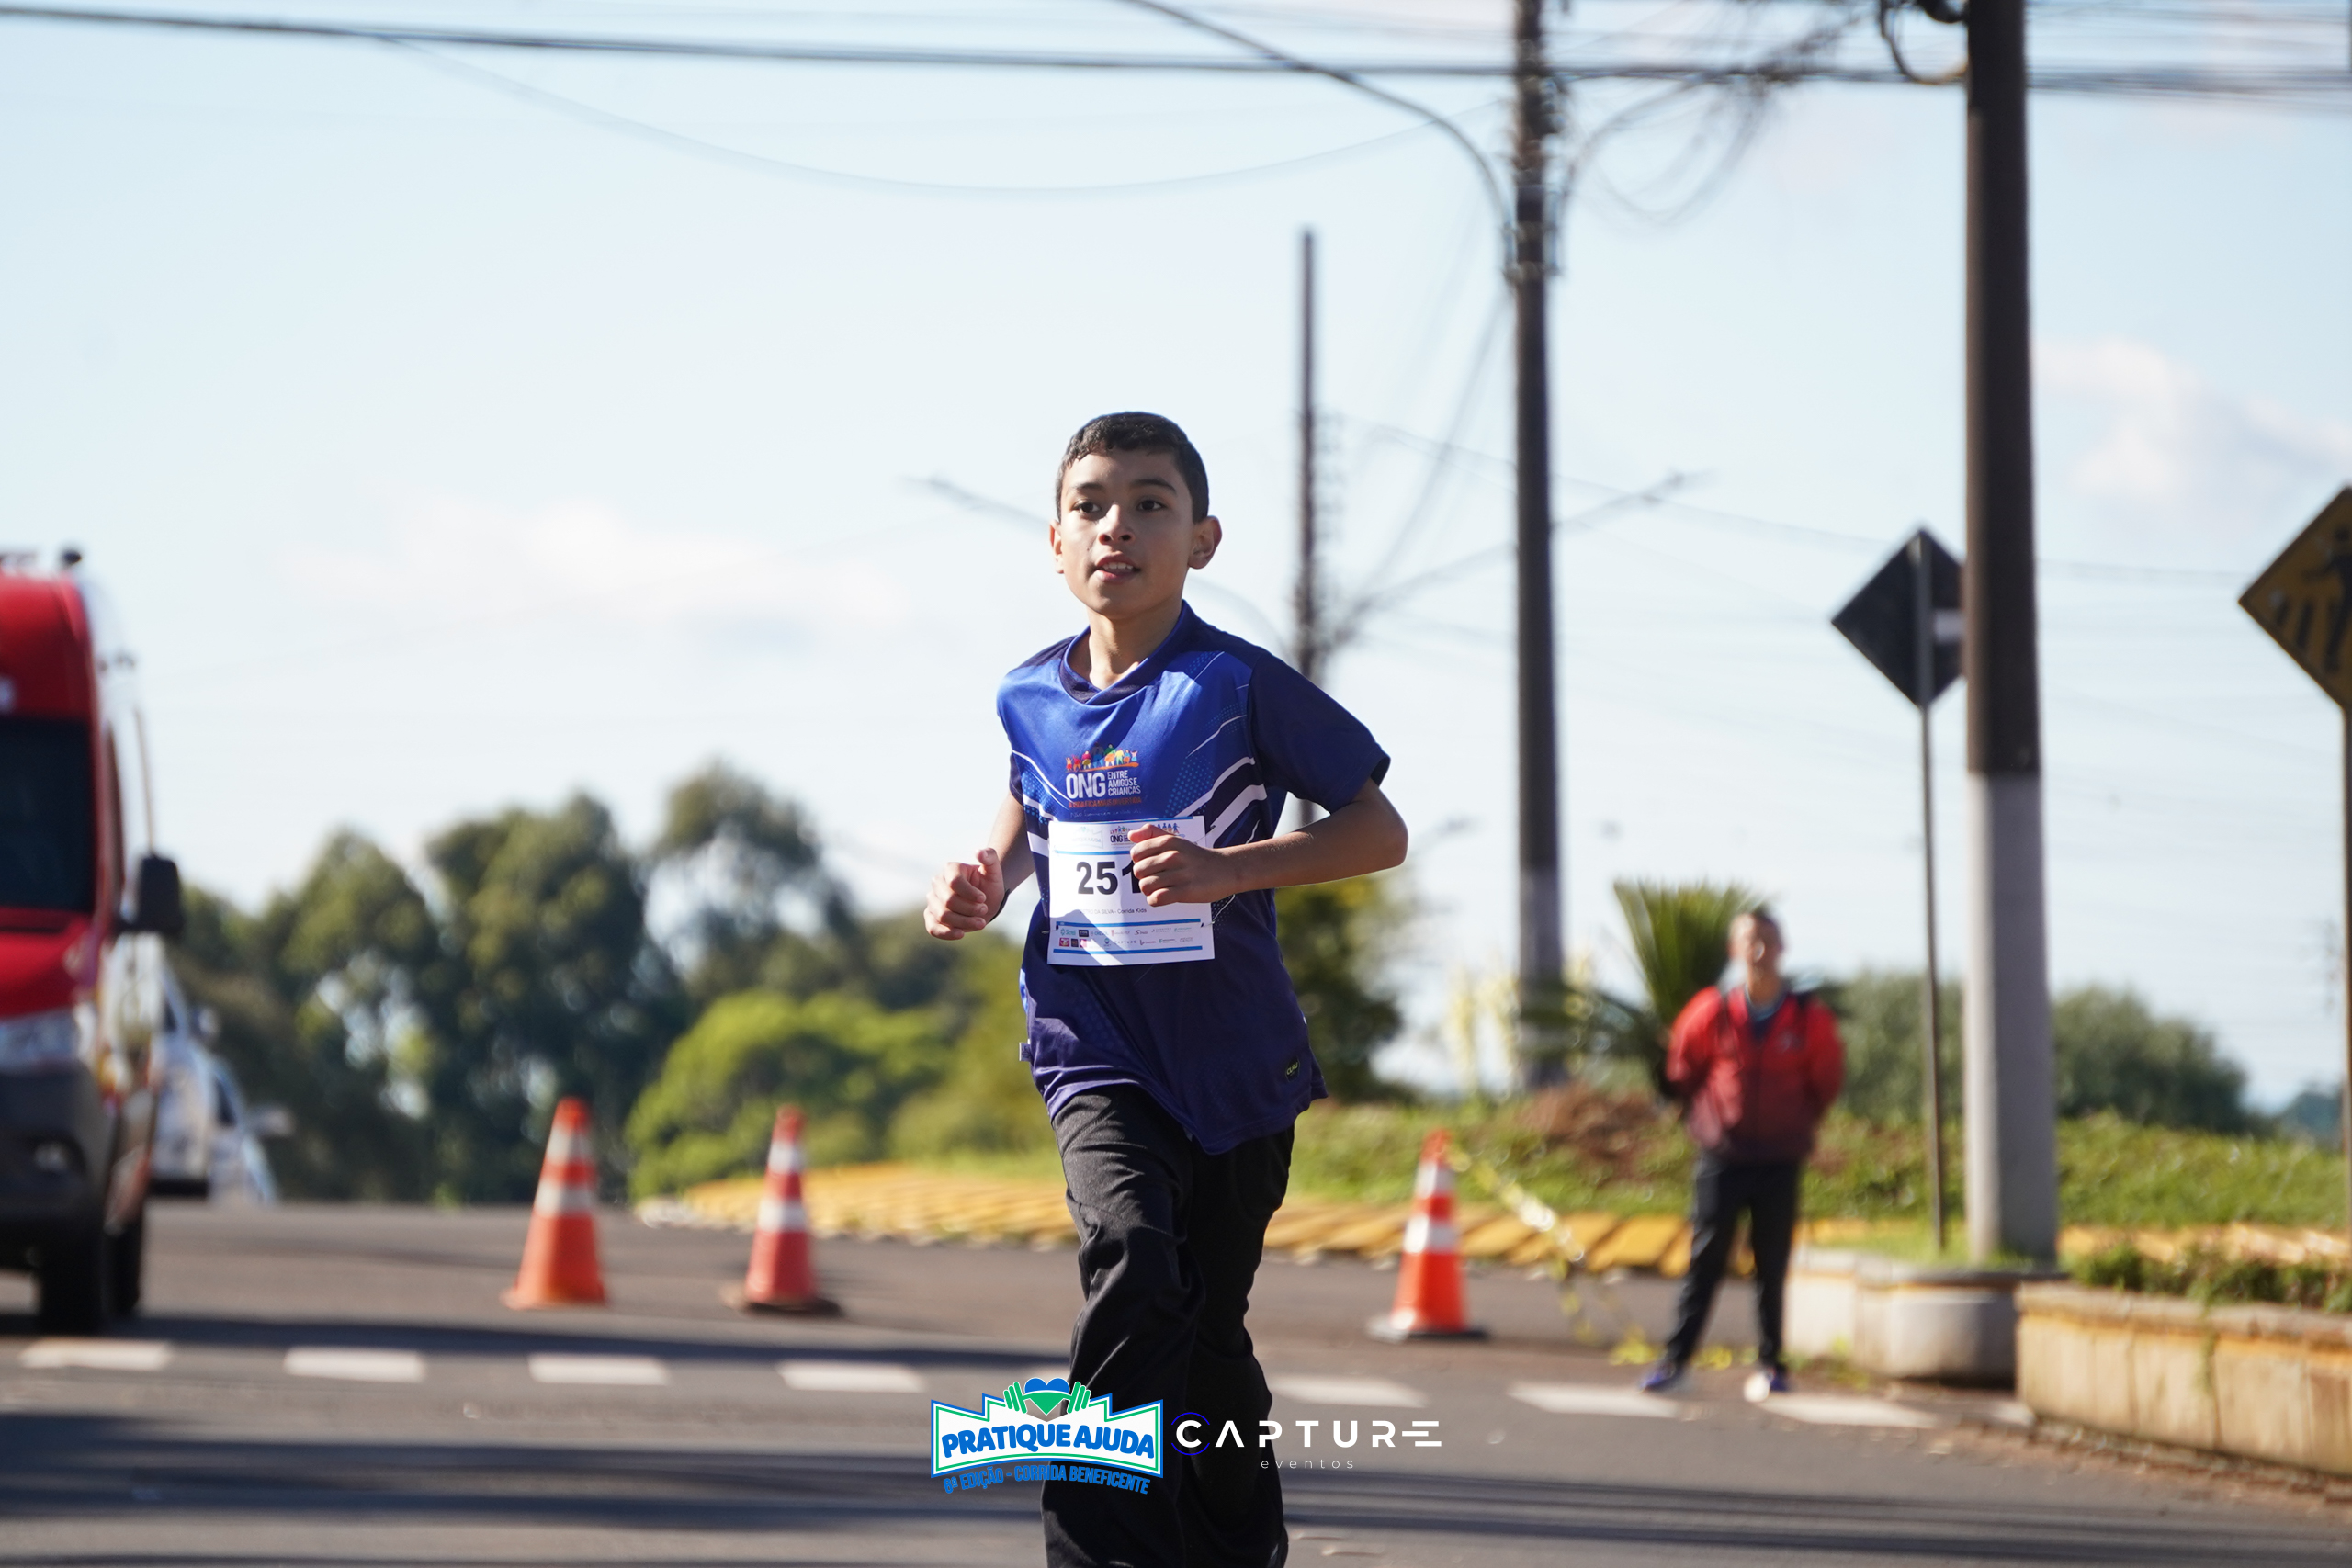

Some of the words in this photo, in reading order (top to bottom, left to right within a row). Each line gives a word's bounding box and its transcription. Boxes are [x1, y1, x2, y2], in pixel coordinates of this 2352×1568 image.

[1107, 770, 1128, 780] ENTRE
[1066, 772, 1106, 799] ONG
[1108, 777, 1133, 788] AMIGOS
[1110, 835, 1124, 843] ONG
